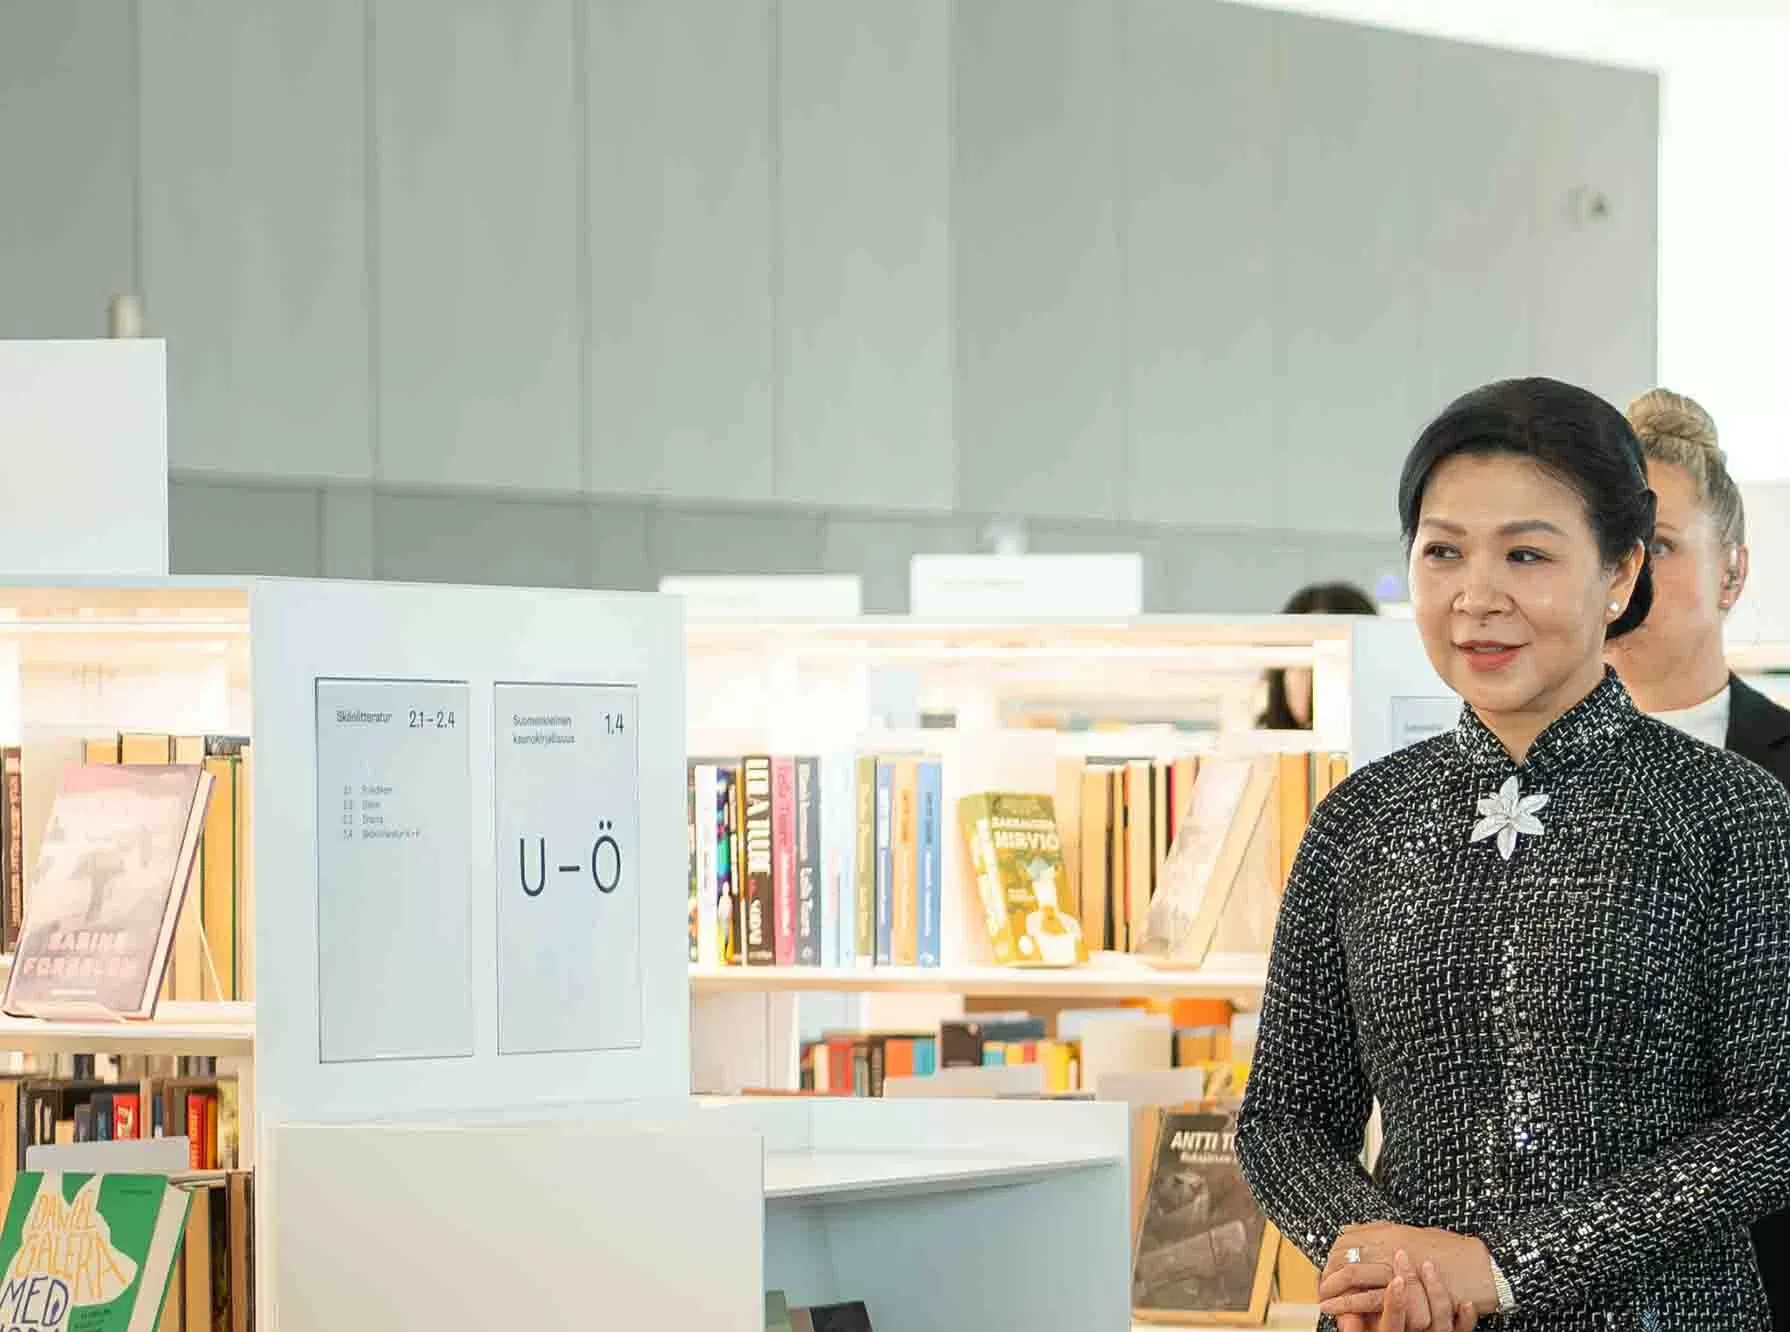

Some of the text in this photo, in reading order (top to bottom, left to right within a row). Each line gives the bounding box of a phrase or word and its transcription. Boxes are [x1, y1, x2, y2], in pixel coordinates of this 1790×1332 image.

[603, 711, 625, 736] 1.4
[1169, 1130, 1219, 1151] ANTTI
[15, 1230, 128, 1300] GALERA
[0, 1275, 69, 1326] MED
